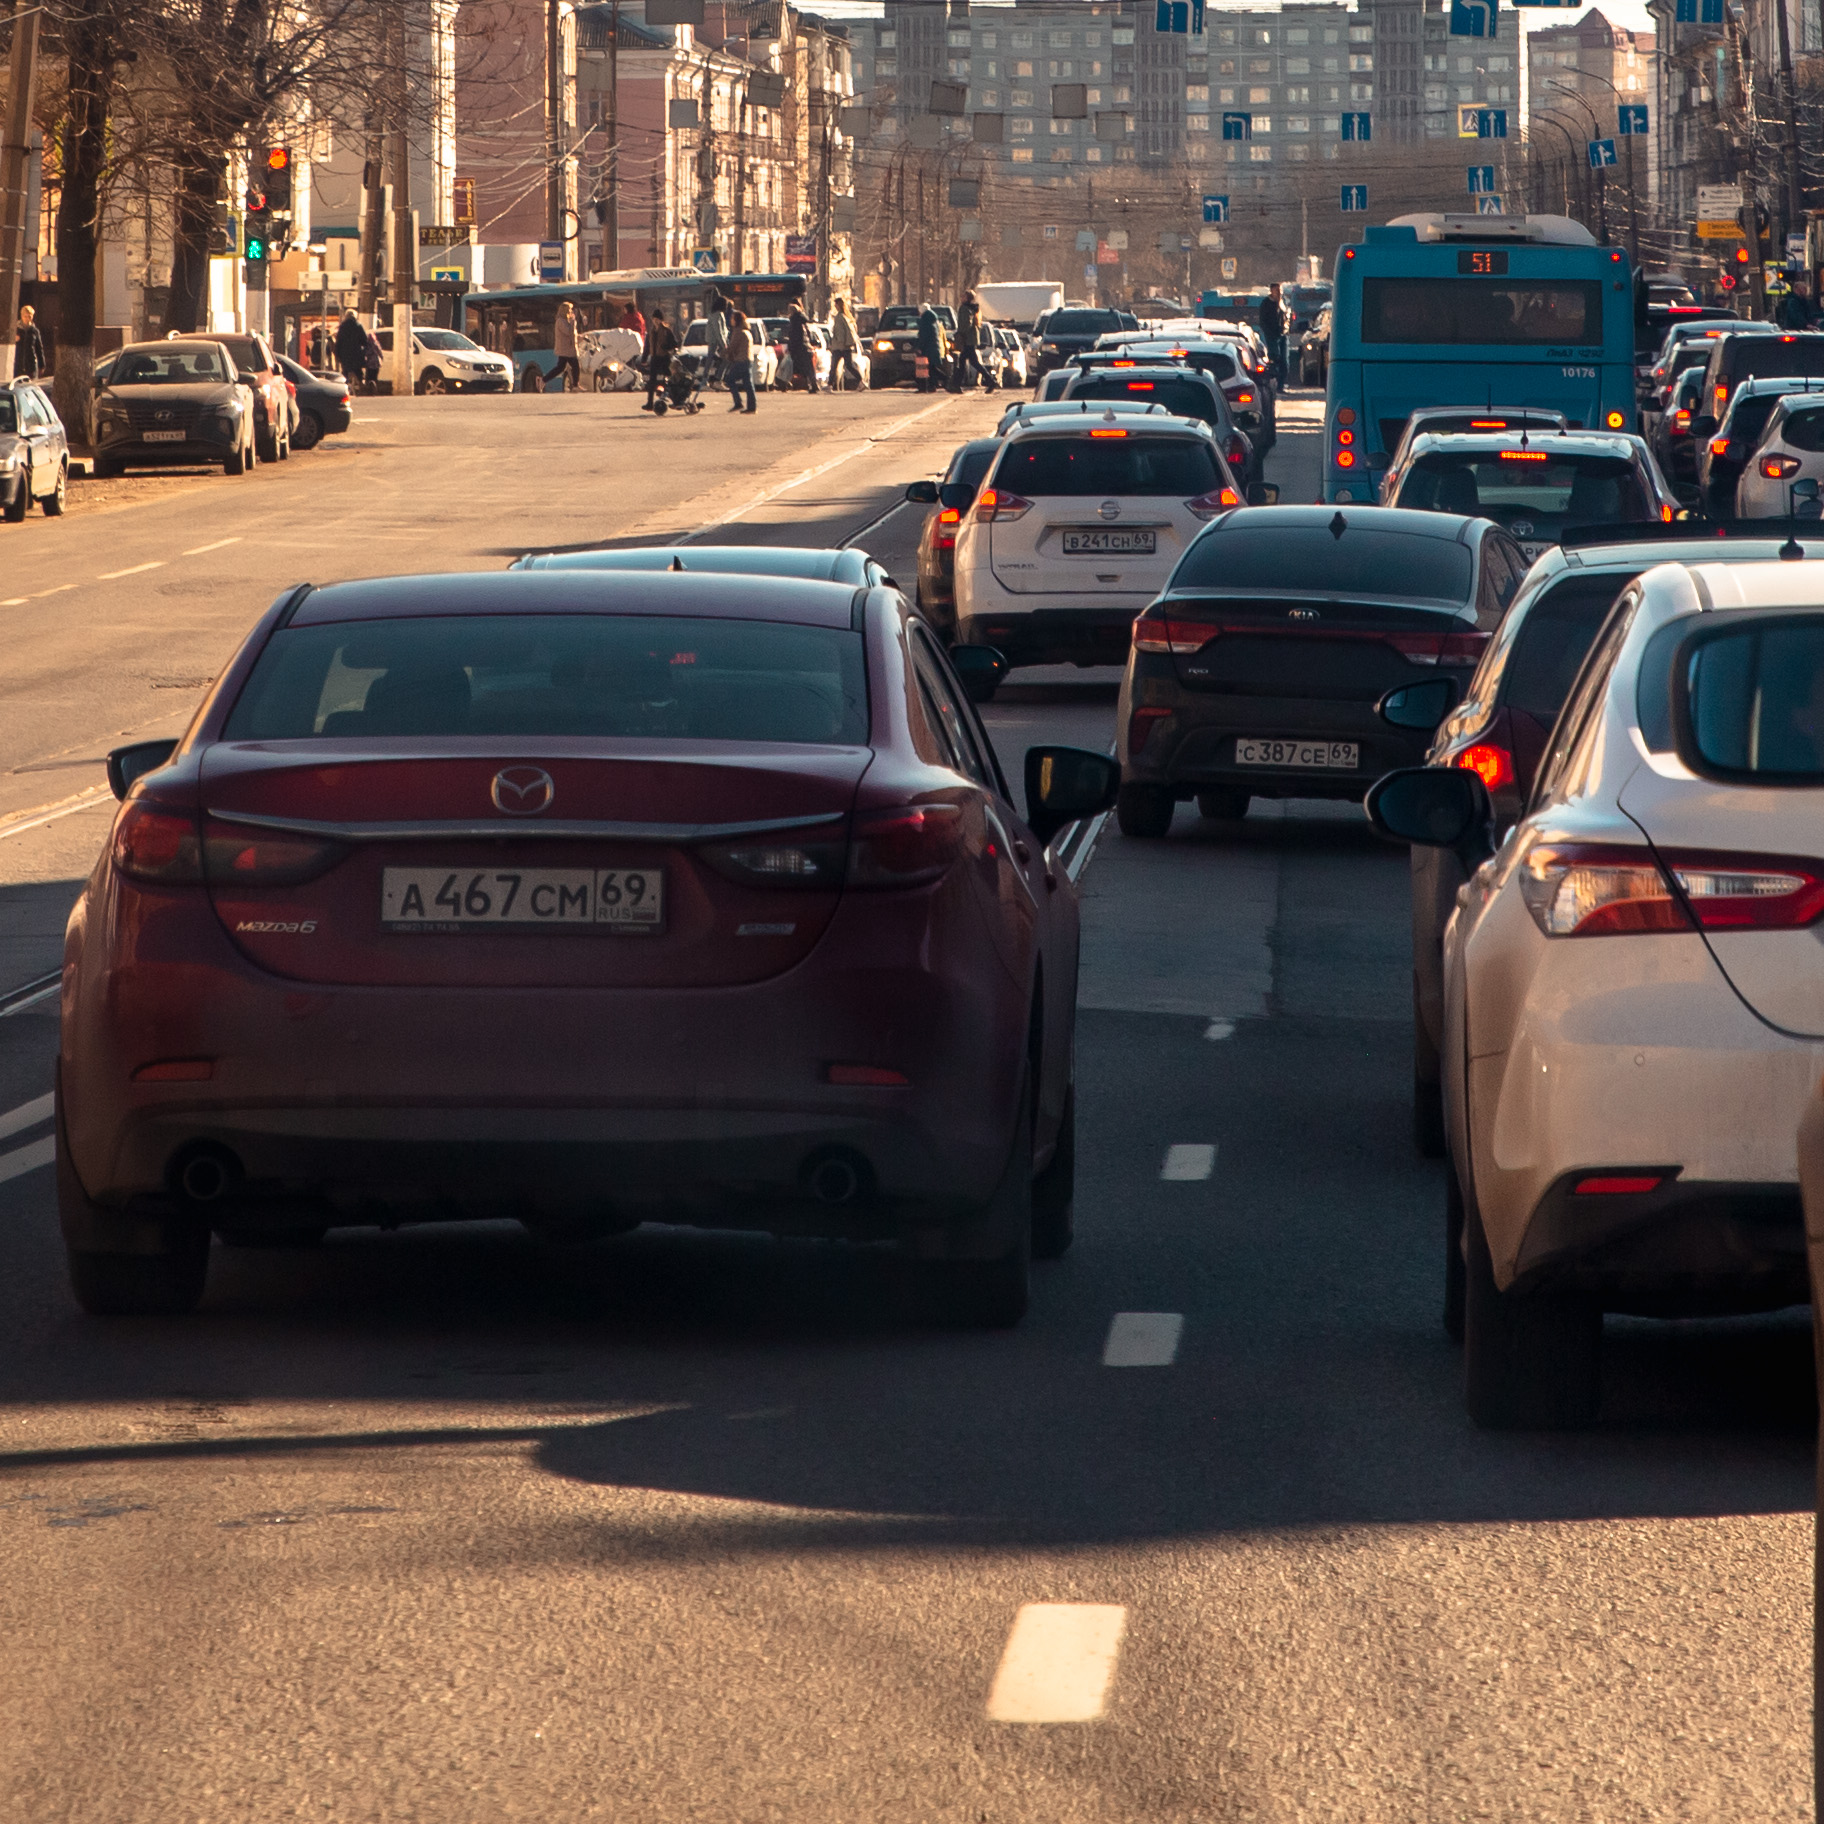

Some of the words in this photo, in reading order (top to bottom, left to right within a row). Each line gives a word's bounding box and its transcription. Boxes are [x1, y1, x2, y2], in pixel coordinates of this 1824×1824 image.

[1472, 252, 1492, 273] 51
[1562, 367, 1596, 378] 10176
[1134, 534, 1149, 545] 69
[1331, 744, 1353, 760] 69
[601, 873, 646, 907] 69
[599, 907, 631, 919] RUS
